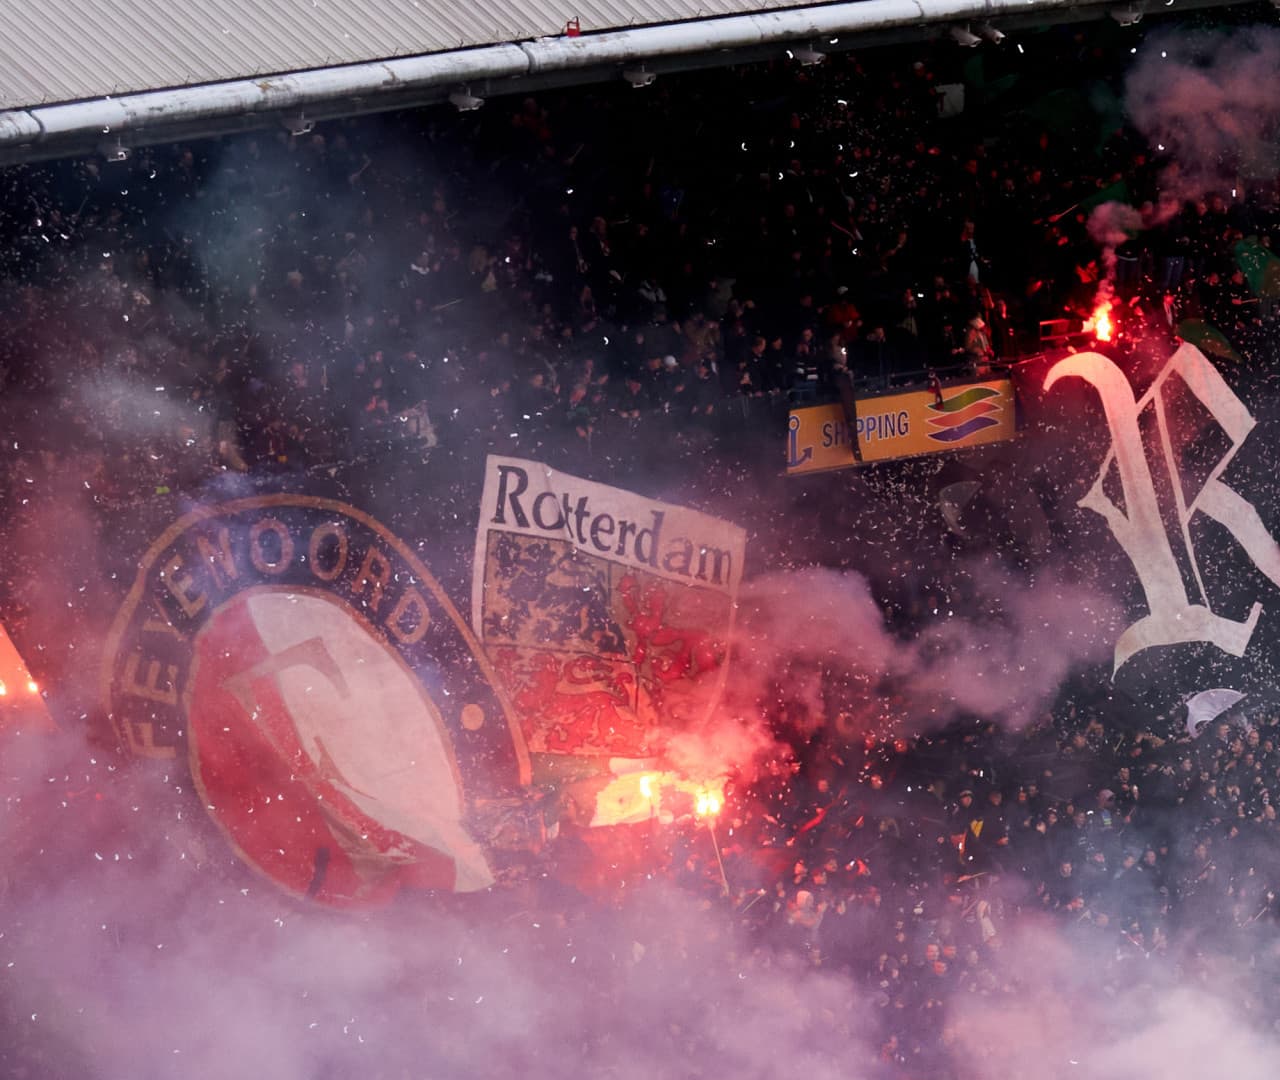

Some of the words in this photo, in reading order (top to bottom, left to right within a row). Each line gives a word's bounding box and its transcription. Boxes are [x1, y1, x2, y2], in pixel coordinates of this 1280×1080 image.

[822, 411, 909, 448] SHPPING
[490, 464, 732, 585] Rotterdam
[121, 517, 431, 760] FEYENOORD
